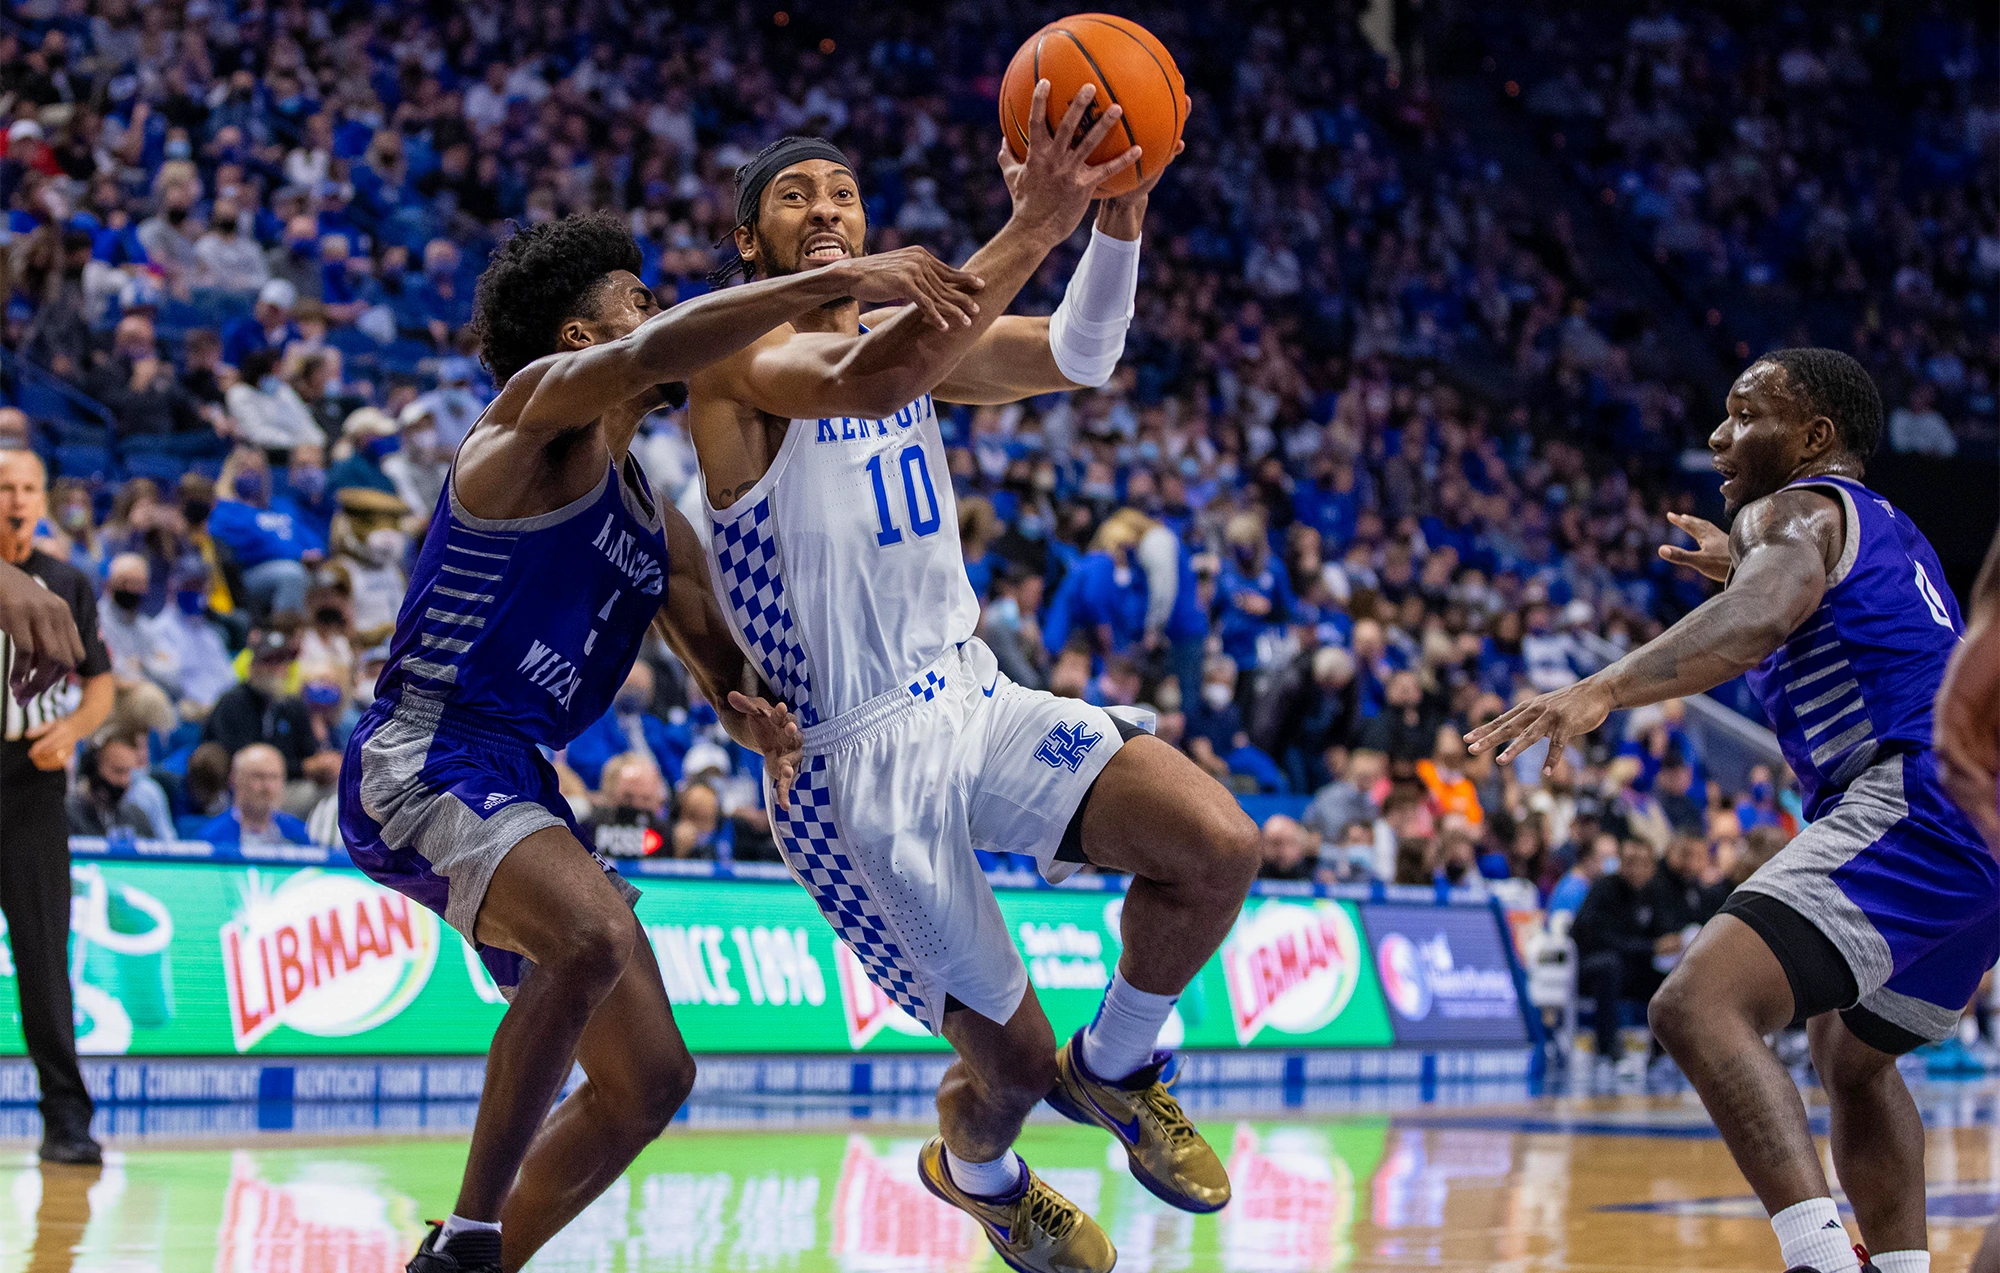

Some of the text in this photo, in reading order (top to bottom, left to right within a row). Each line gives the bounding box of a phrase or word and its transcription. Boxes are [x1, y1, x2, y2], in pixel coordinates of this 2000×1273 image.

[865, 444, 941, 547] 10
[1033, 720, 1103, 774] UK
[228, 893, 415, 1035] LIBMAN
[644, 923, 740, 1005] INCE
